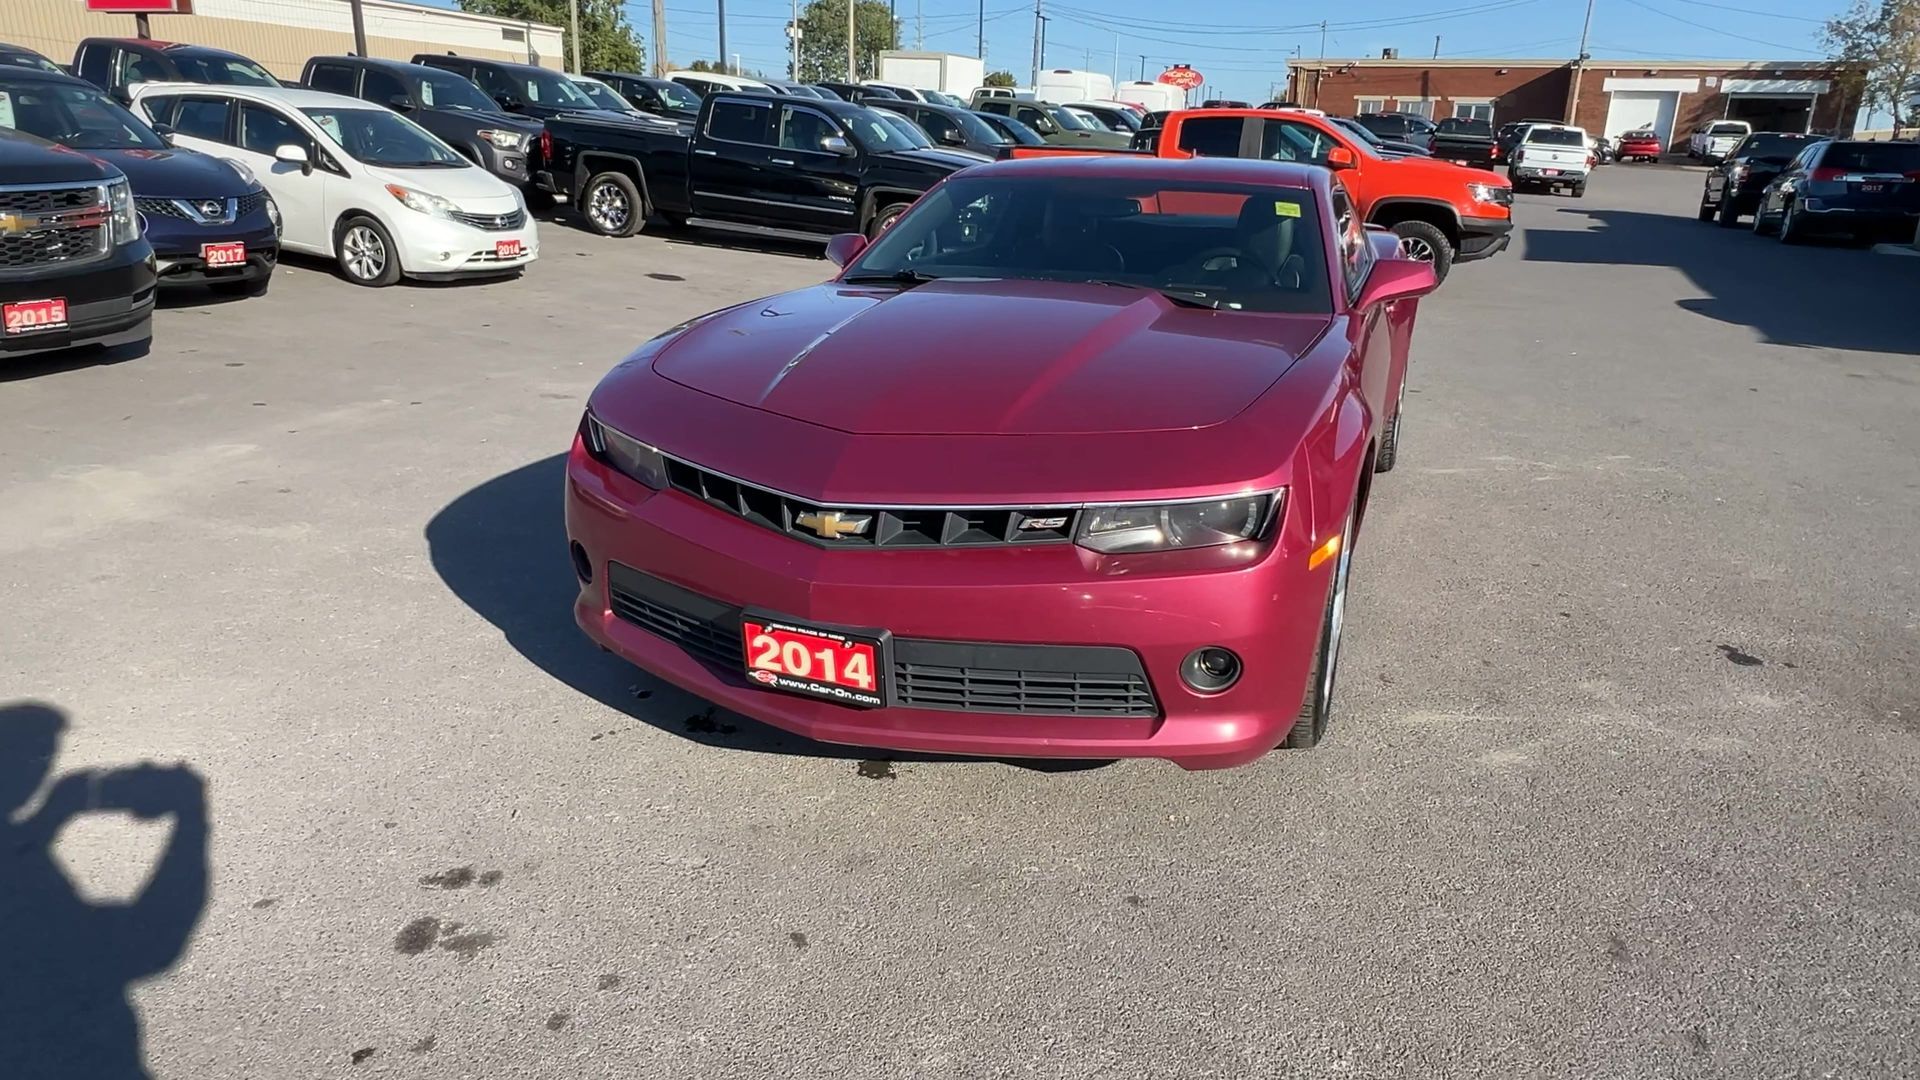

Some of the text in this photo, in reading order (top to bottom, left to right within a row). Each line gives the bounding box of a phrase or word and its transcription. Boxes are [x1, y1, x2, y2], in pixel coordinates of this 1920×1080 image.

[208, 248, 243, 263] 2017
[498, 244, 519, 256] 2014
[7, 306, 64, 328] 2015
[1018, 516, 1068, 529] RS
[752, 634, 872, 690] 2014
[778, 678, 881, 705] www.Car-On.com
